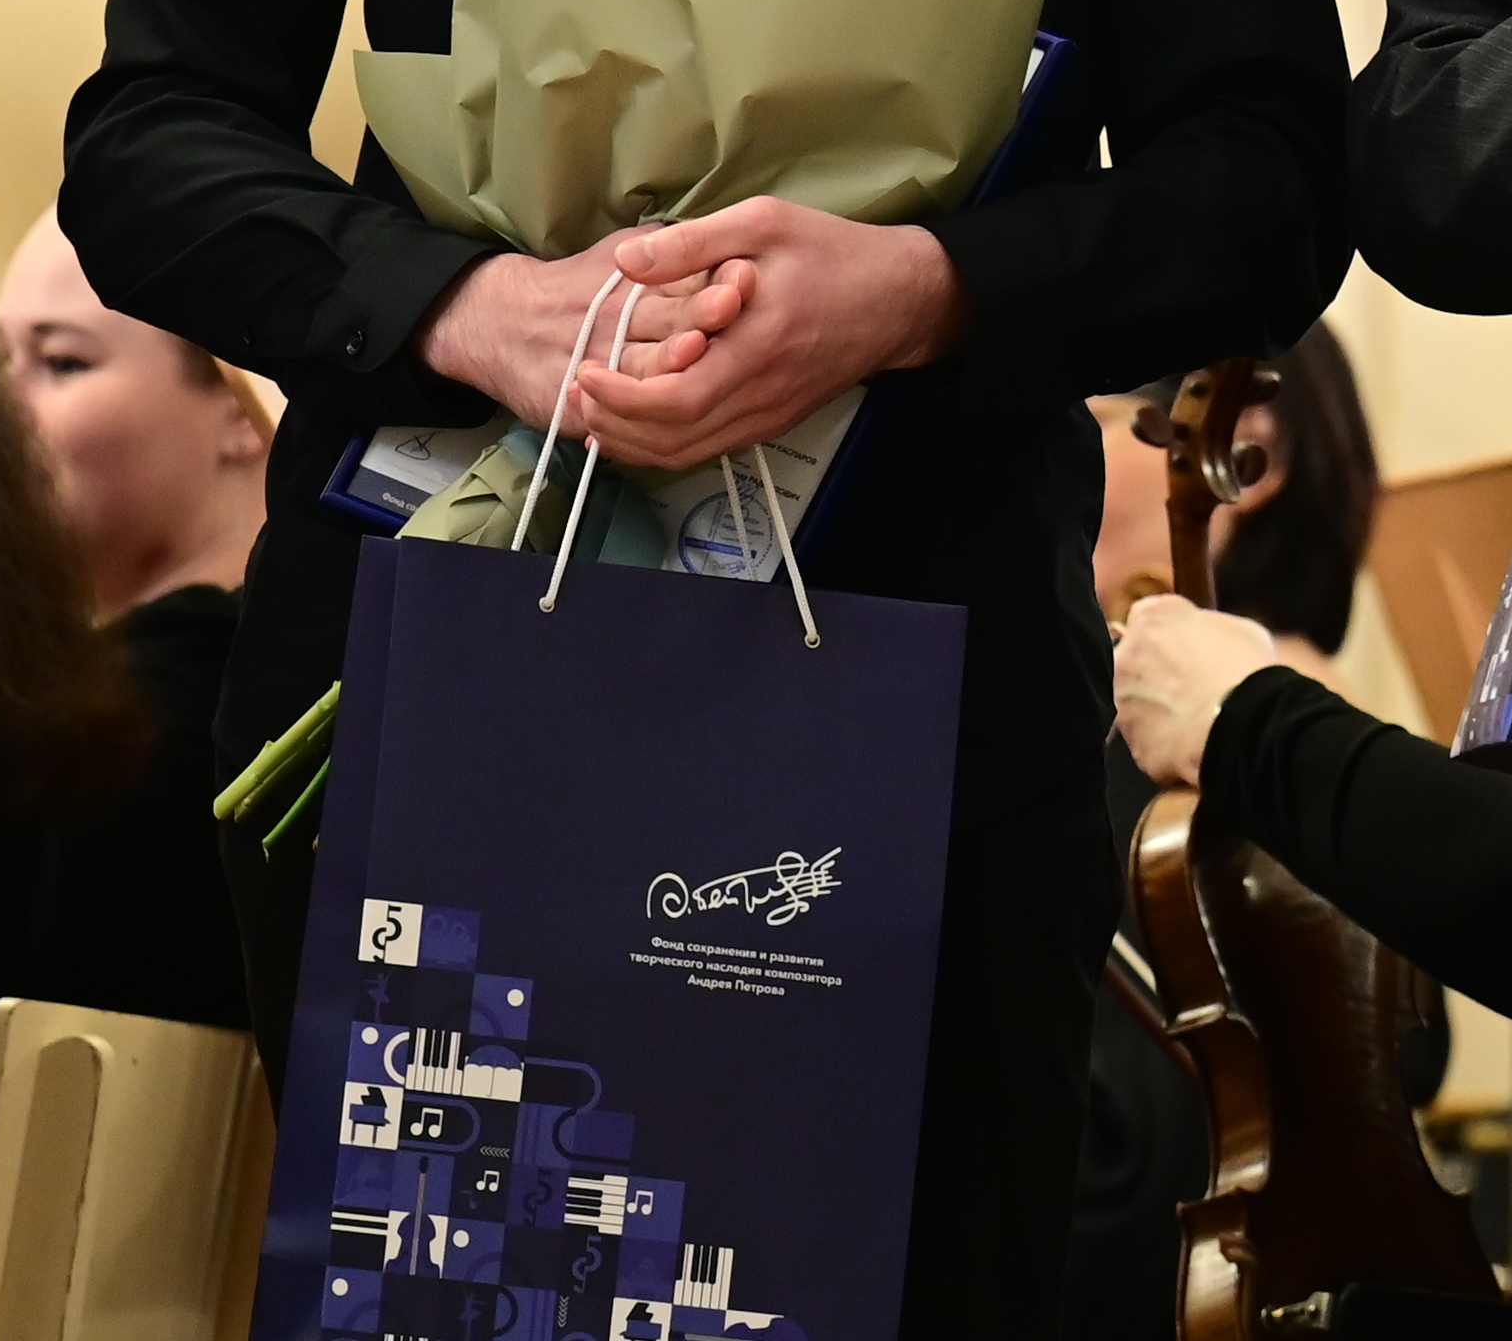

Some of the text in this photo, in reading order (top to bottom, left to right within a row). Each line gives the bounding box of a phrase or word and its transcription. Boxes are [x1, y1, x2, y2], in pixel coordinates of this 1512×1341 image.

[651, 936, 824, 967] Фонд сохранения и развития
[629, 952, 842, 987] творческого наследия композитора
[687, 974, 785, 996] Андрея Петрова
